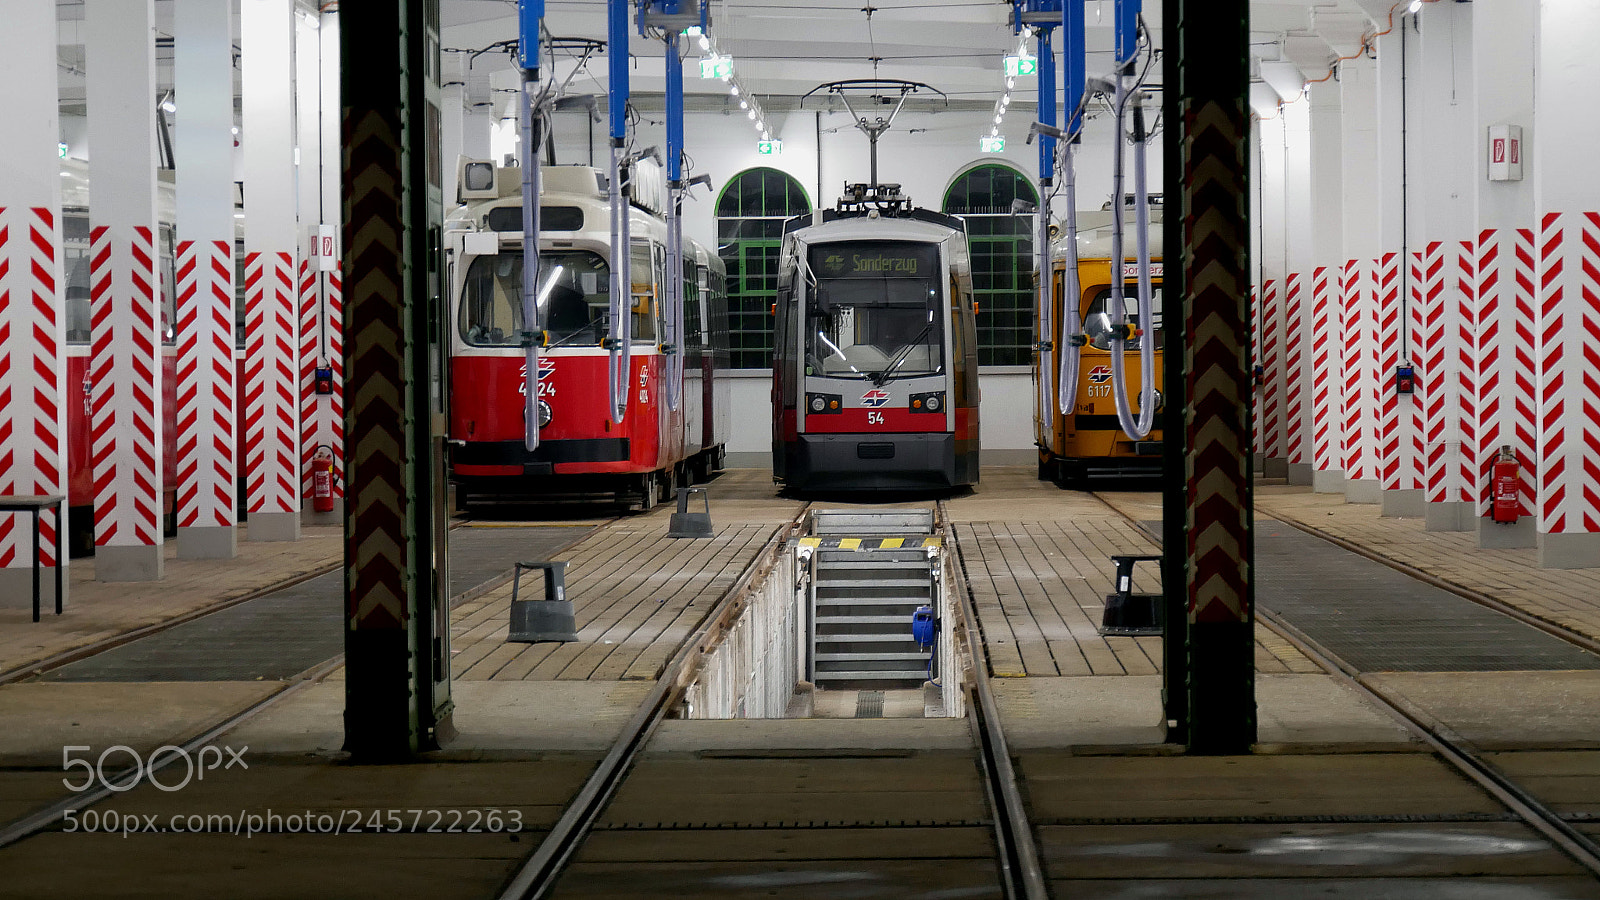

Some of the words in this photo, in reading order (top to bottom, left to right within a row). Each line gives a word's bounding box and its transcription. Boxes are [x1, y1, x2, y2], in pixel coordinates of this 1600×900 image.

[853, 254, 917, 274] Sonderzug
[518, 382, 556, 397] 424
[1088, 385, 1111, 397] 6117
[868, 411, 885, 425] 54
